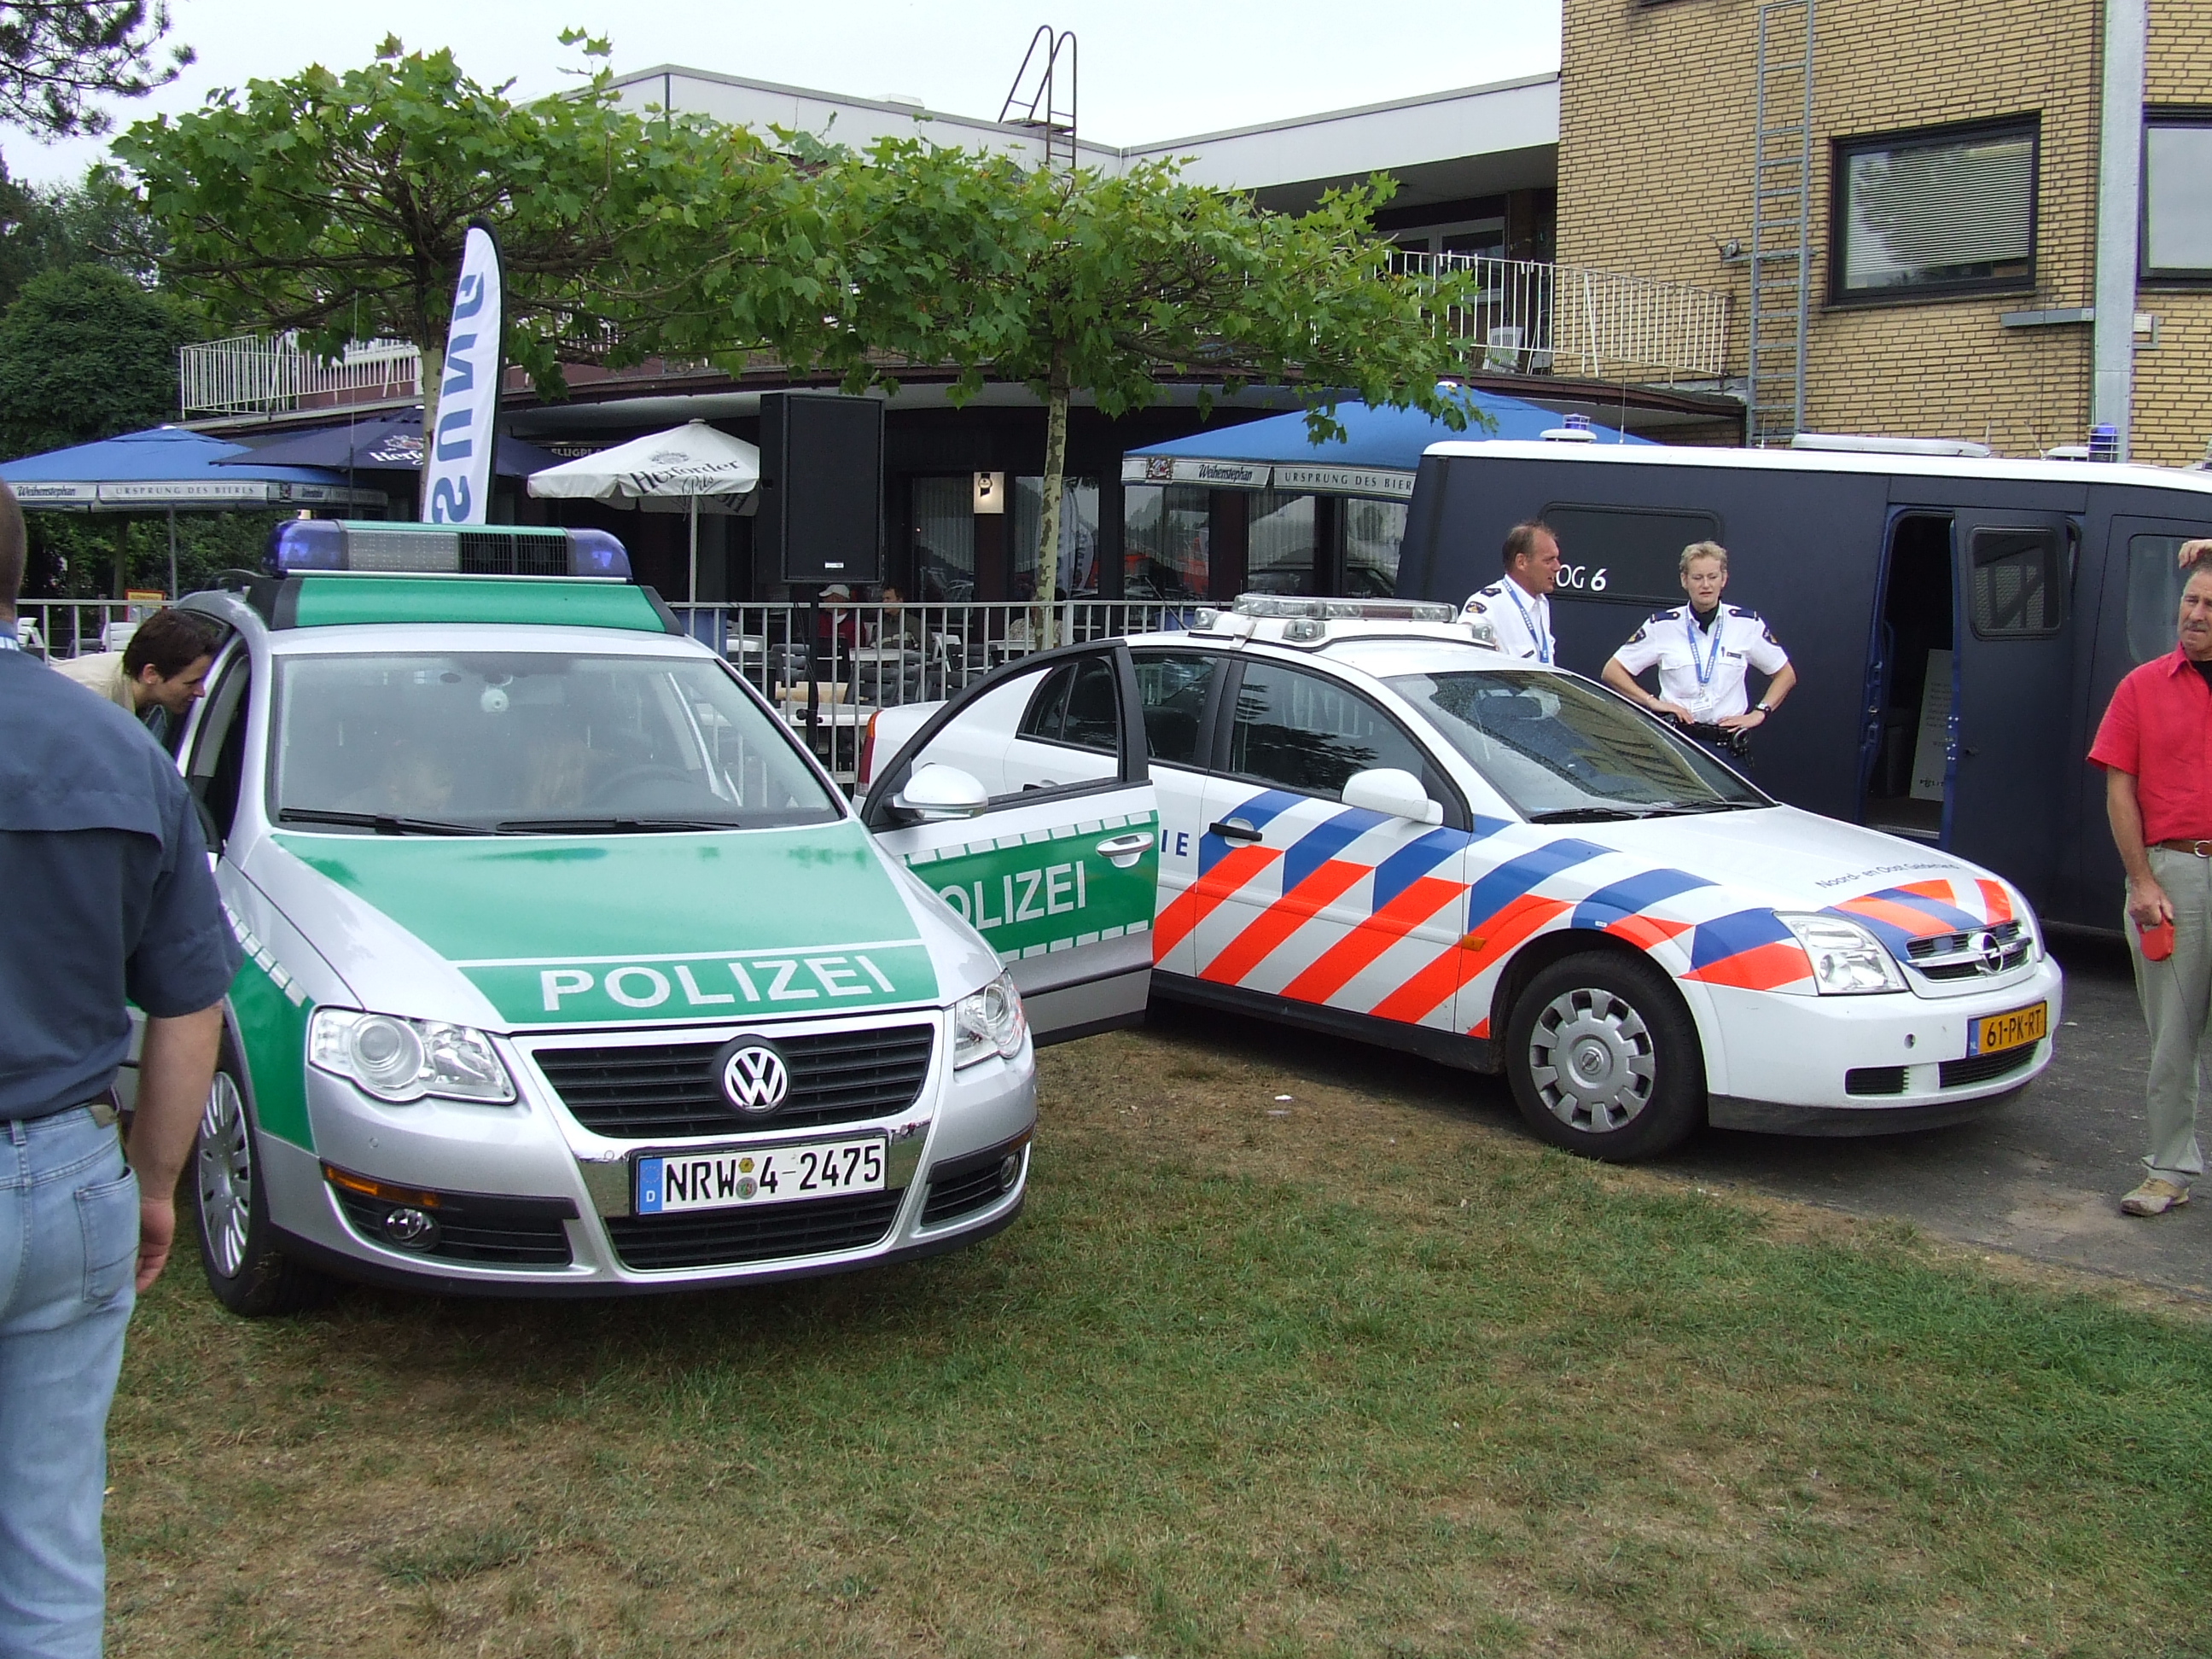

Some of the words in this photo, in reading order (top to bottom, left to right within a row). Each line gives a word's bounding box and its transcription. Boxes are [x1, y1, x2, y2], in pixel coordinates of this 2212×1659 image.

[628, 459, 740, 494] Herforder
[1198, 463, 1253, 483] Weihenstephan
[1284, 472, 1348, 486] URSPRUNG
[1355, 475, 1377, 487] DES
[17, 485, 77, 498] Weihenstephan
[115, 486, 181, 495] URSPRUNG
[1590, 568, 1607, 591] 6
[1161, 829, 1190, 857] IE
[1814, 872, 1860, 888] Noord-
[1876, 864, 1905, 874] Oost
[539, 955, 896, 1011] POLIZEI
[1987, 1009, 2041, 1046] 61-PK-RT
[666, 1158, 736, 1202] NRW
[645, 1190, 656, 1203] D
